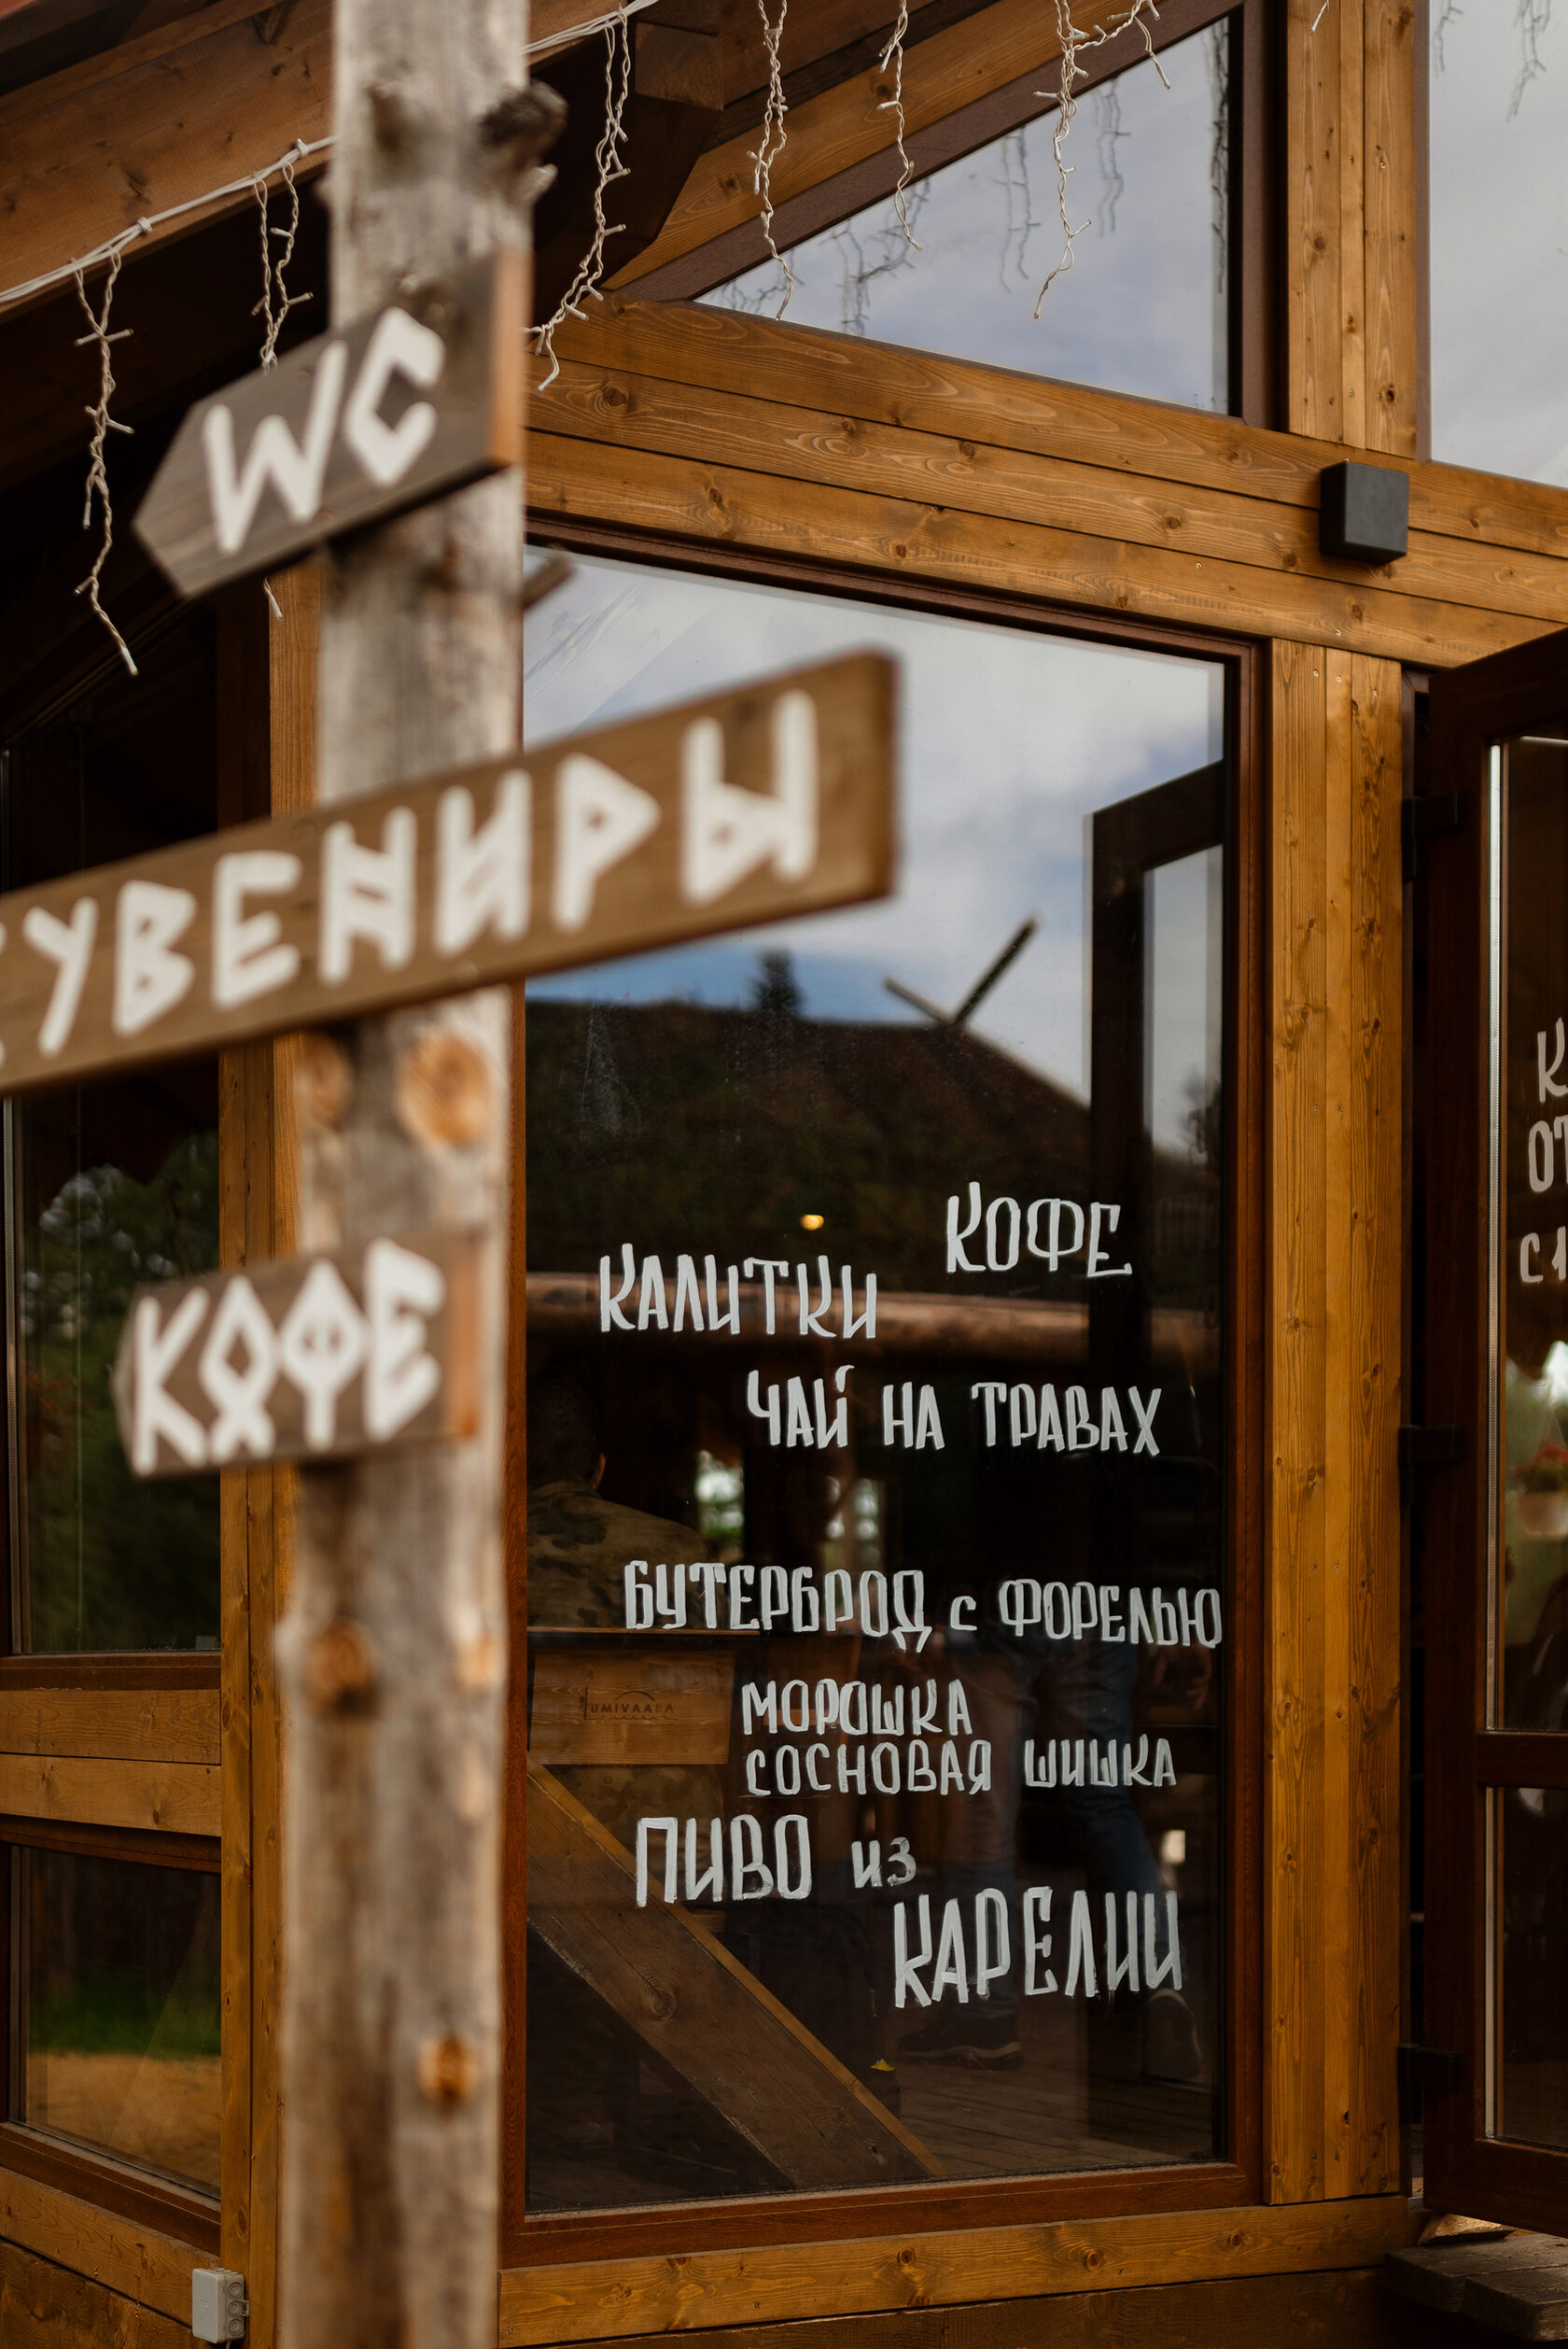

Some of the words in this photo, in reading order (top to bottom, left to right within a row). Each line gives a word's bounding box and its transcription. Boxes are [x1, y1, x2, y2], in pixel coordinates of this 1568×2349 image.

[203, 307, 446, 555] WC
[0, 688, 818, 1066] УВЕНИРЫ
[946, 1181, 1133, 1277] КОФЕ
[599, 1243, 877, 1339] КАЛИТКИ
[131, 1237, 446, 1474] КОФЕ
[747, 1364, 855, 1449] ЧАЙ
[882, 1381, 945, 1450] НА
[971, 1382, 1162, 1456] ТРАВАХ
[623, 1560, 932, 1653] БУТЕРБРОД
[999, 1578, 1222, 1649] ФОРЕЛЬЮ
[741, 1678, 973, 1736] МОРОШКА
[746, 1738, 992, 1796] СОСНОВАЯ
[1024, 1734, 1177, 1788] ШИШКА
[636, 1814, 812, 1907] ПИВО
[893, 1886, 1183, 2008] КАРЕЛИИ
